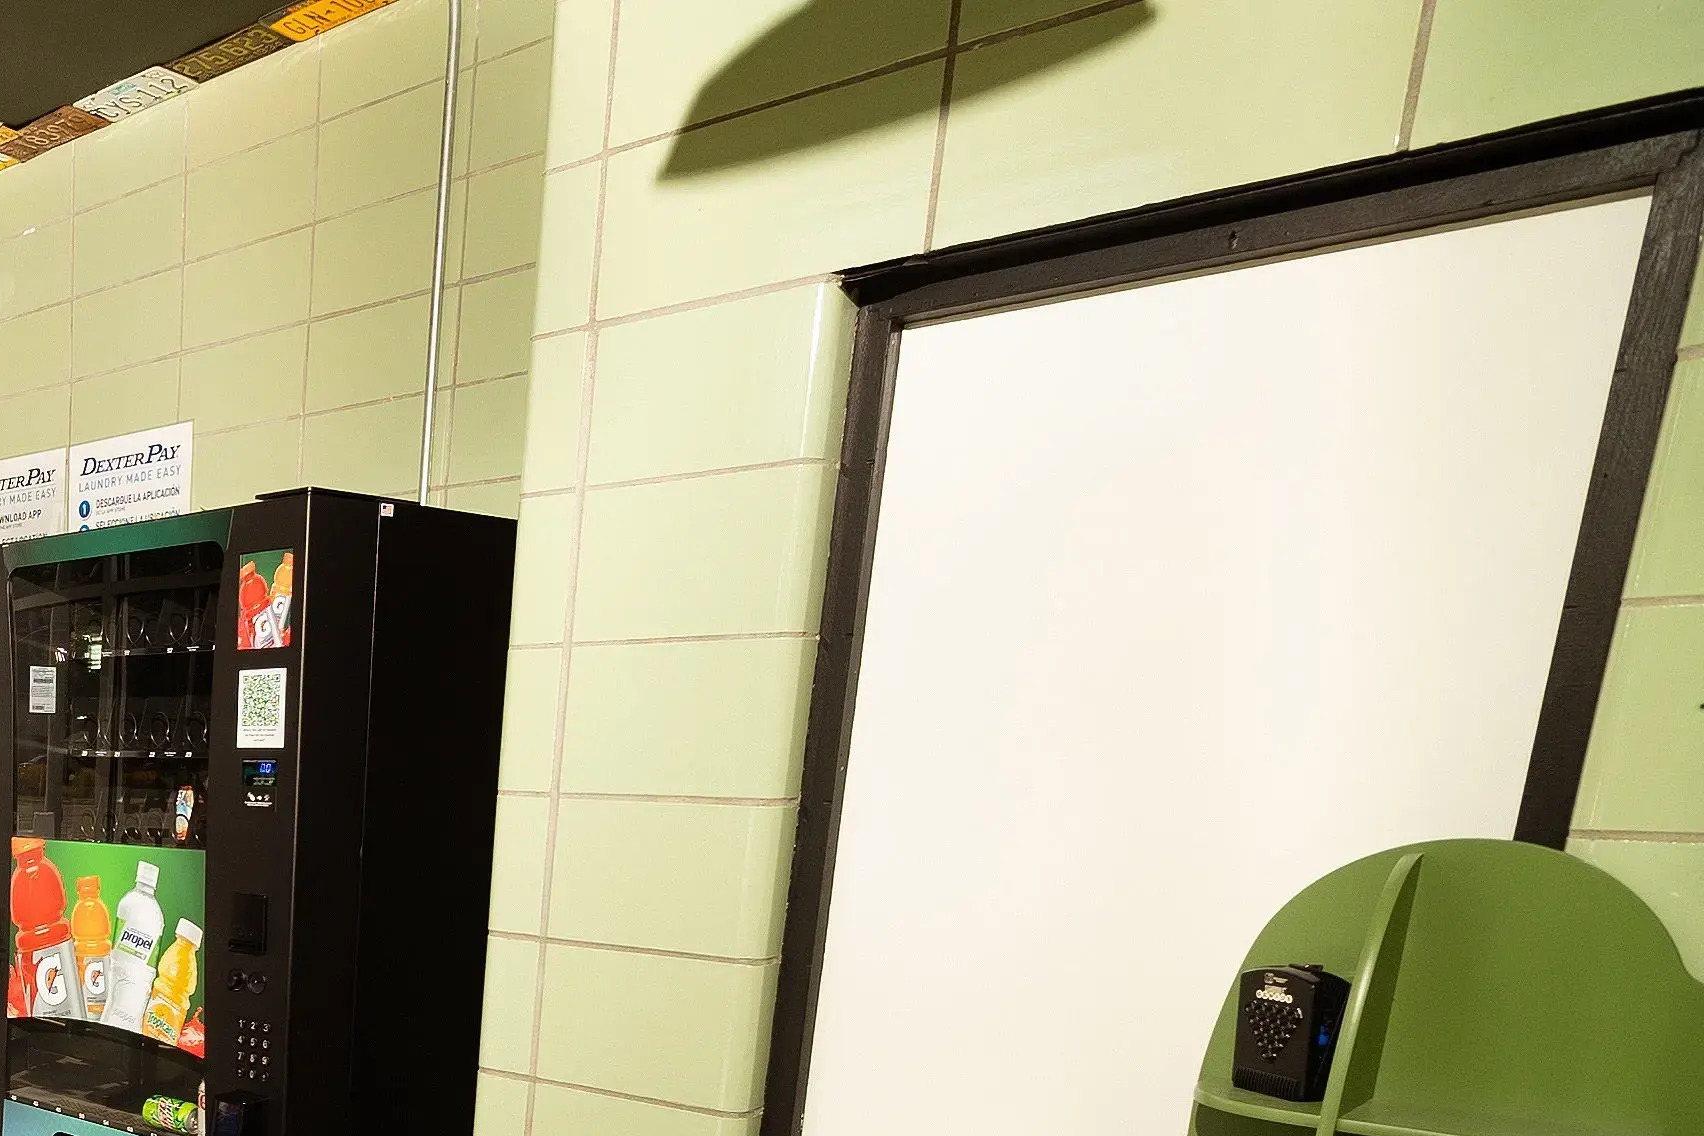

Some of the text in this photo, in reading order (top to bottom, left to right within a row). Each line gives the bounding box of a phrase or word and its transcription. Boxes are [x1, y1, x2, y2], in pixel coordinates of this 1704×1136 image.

[79, 464, 181, 492] LAUNDRY MADE EASY
[10, 492, 33, 505] MADE
[36, 488, 56, 501] EASY
[28, 508, 42, 520] APP
[121, 930, 154, 950] propel
